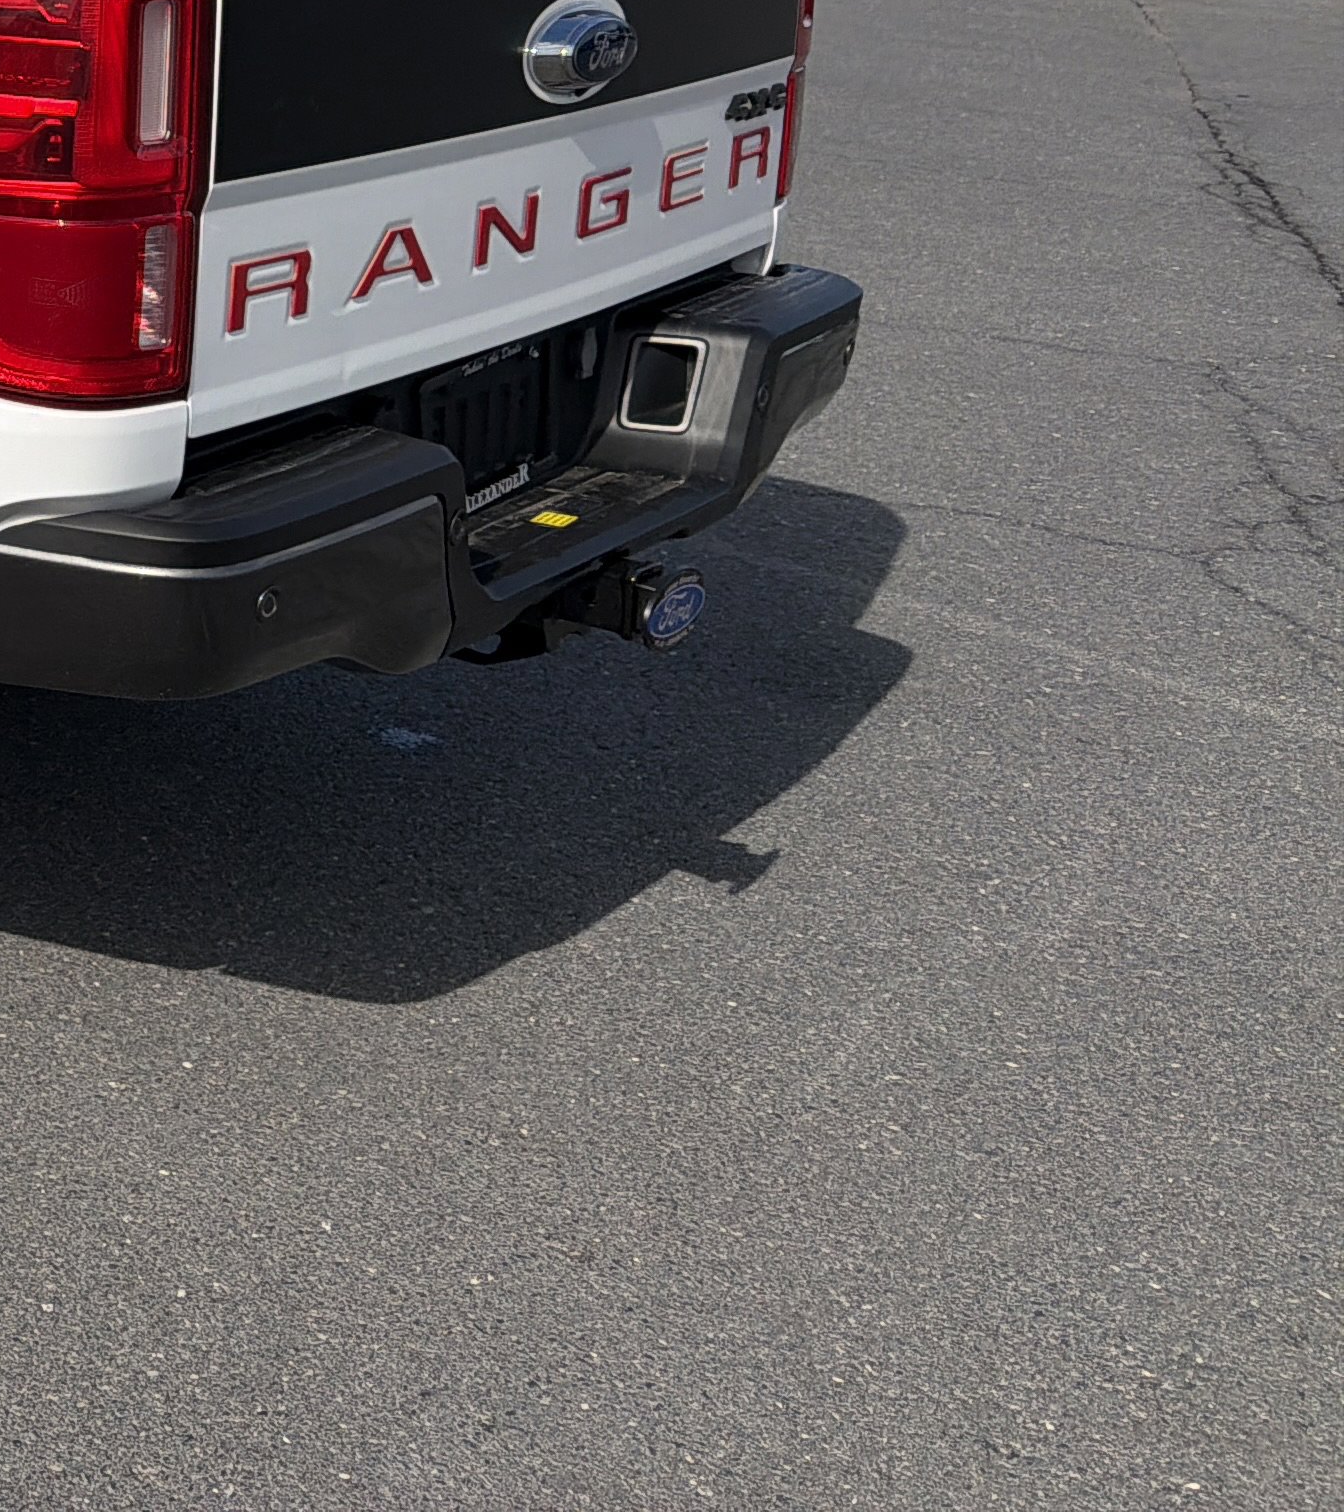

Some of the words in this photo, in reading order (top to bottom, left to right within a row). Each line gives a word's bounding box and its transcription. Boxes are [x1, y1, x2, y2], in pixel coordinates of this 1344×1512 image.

[588, 30, 631, 71] Ford
[225, 125, 772, 336] RANGER
[658, 590, 696, 632] Ford
